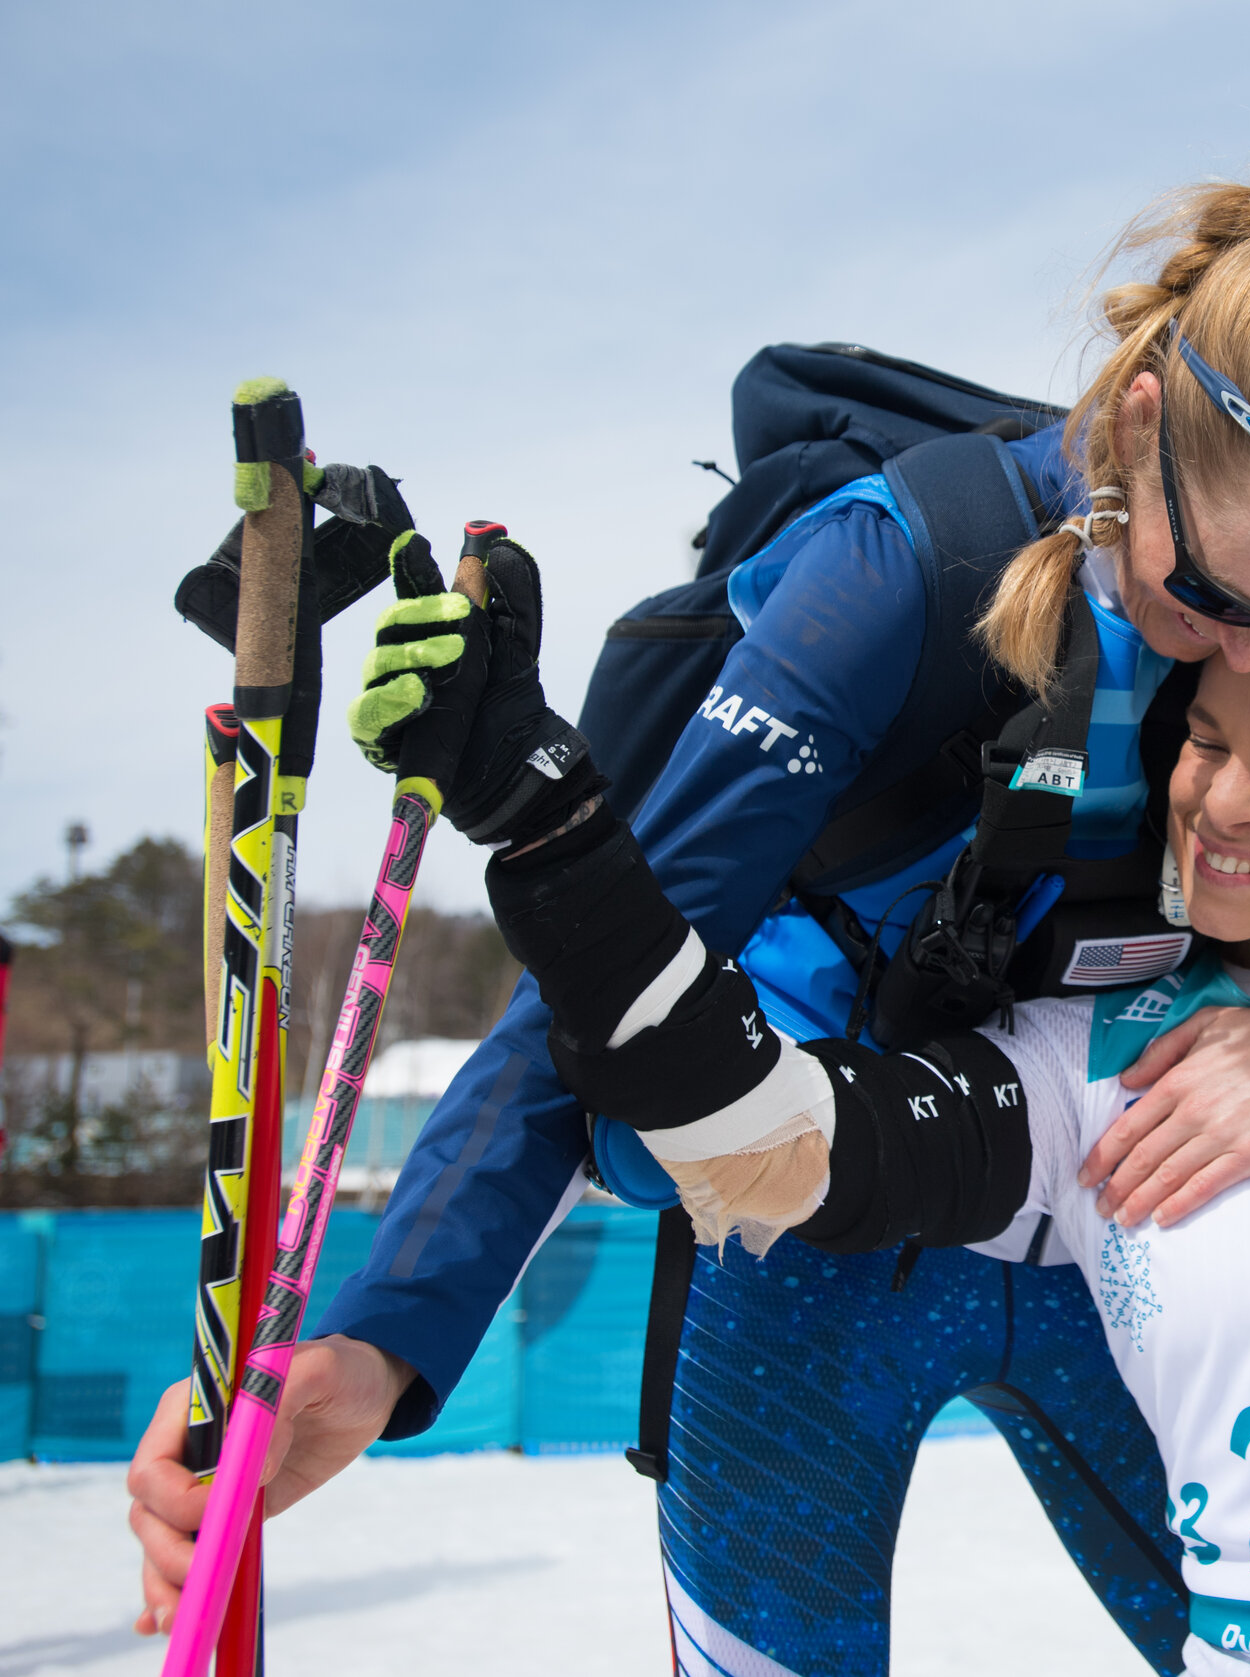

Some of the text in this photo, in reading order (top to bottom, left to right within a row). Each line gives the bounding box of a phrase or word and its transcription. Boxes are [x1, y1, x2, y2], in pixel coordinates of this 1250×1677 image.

[1038, 772, 1074, 788] ABT
[280, 792, 297, 812] R
[993, 1083, 1018, 1108] KT
[908, 1094, 939, 1121] KT
